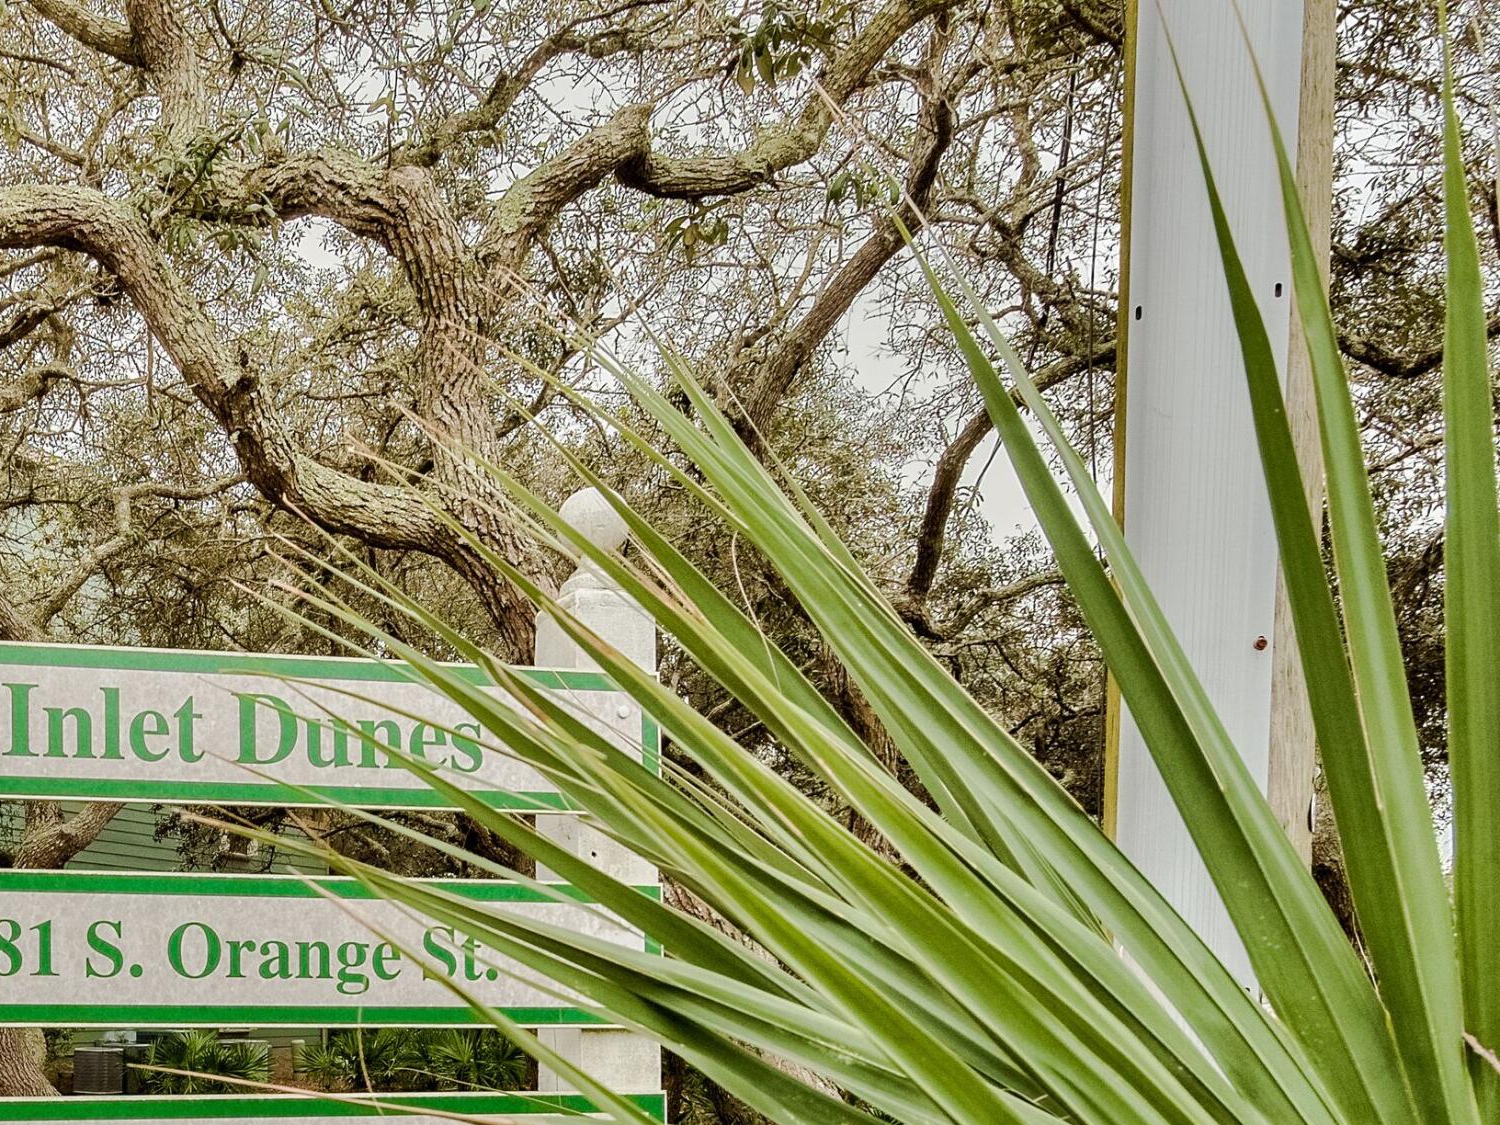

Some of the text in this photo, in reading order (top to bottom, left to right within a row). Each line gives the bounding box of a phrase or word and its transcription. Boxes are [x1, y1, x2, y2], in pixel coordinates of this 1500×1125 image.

[1, 682, 484, 774] Inlet Dunes
[85, 920, 143, 979] S.
[167, 921, 402, 995] Orange
[422, 926, 499, 981] St.
